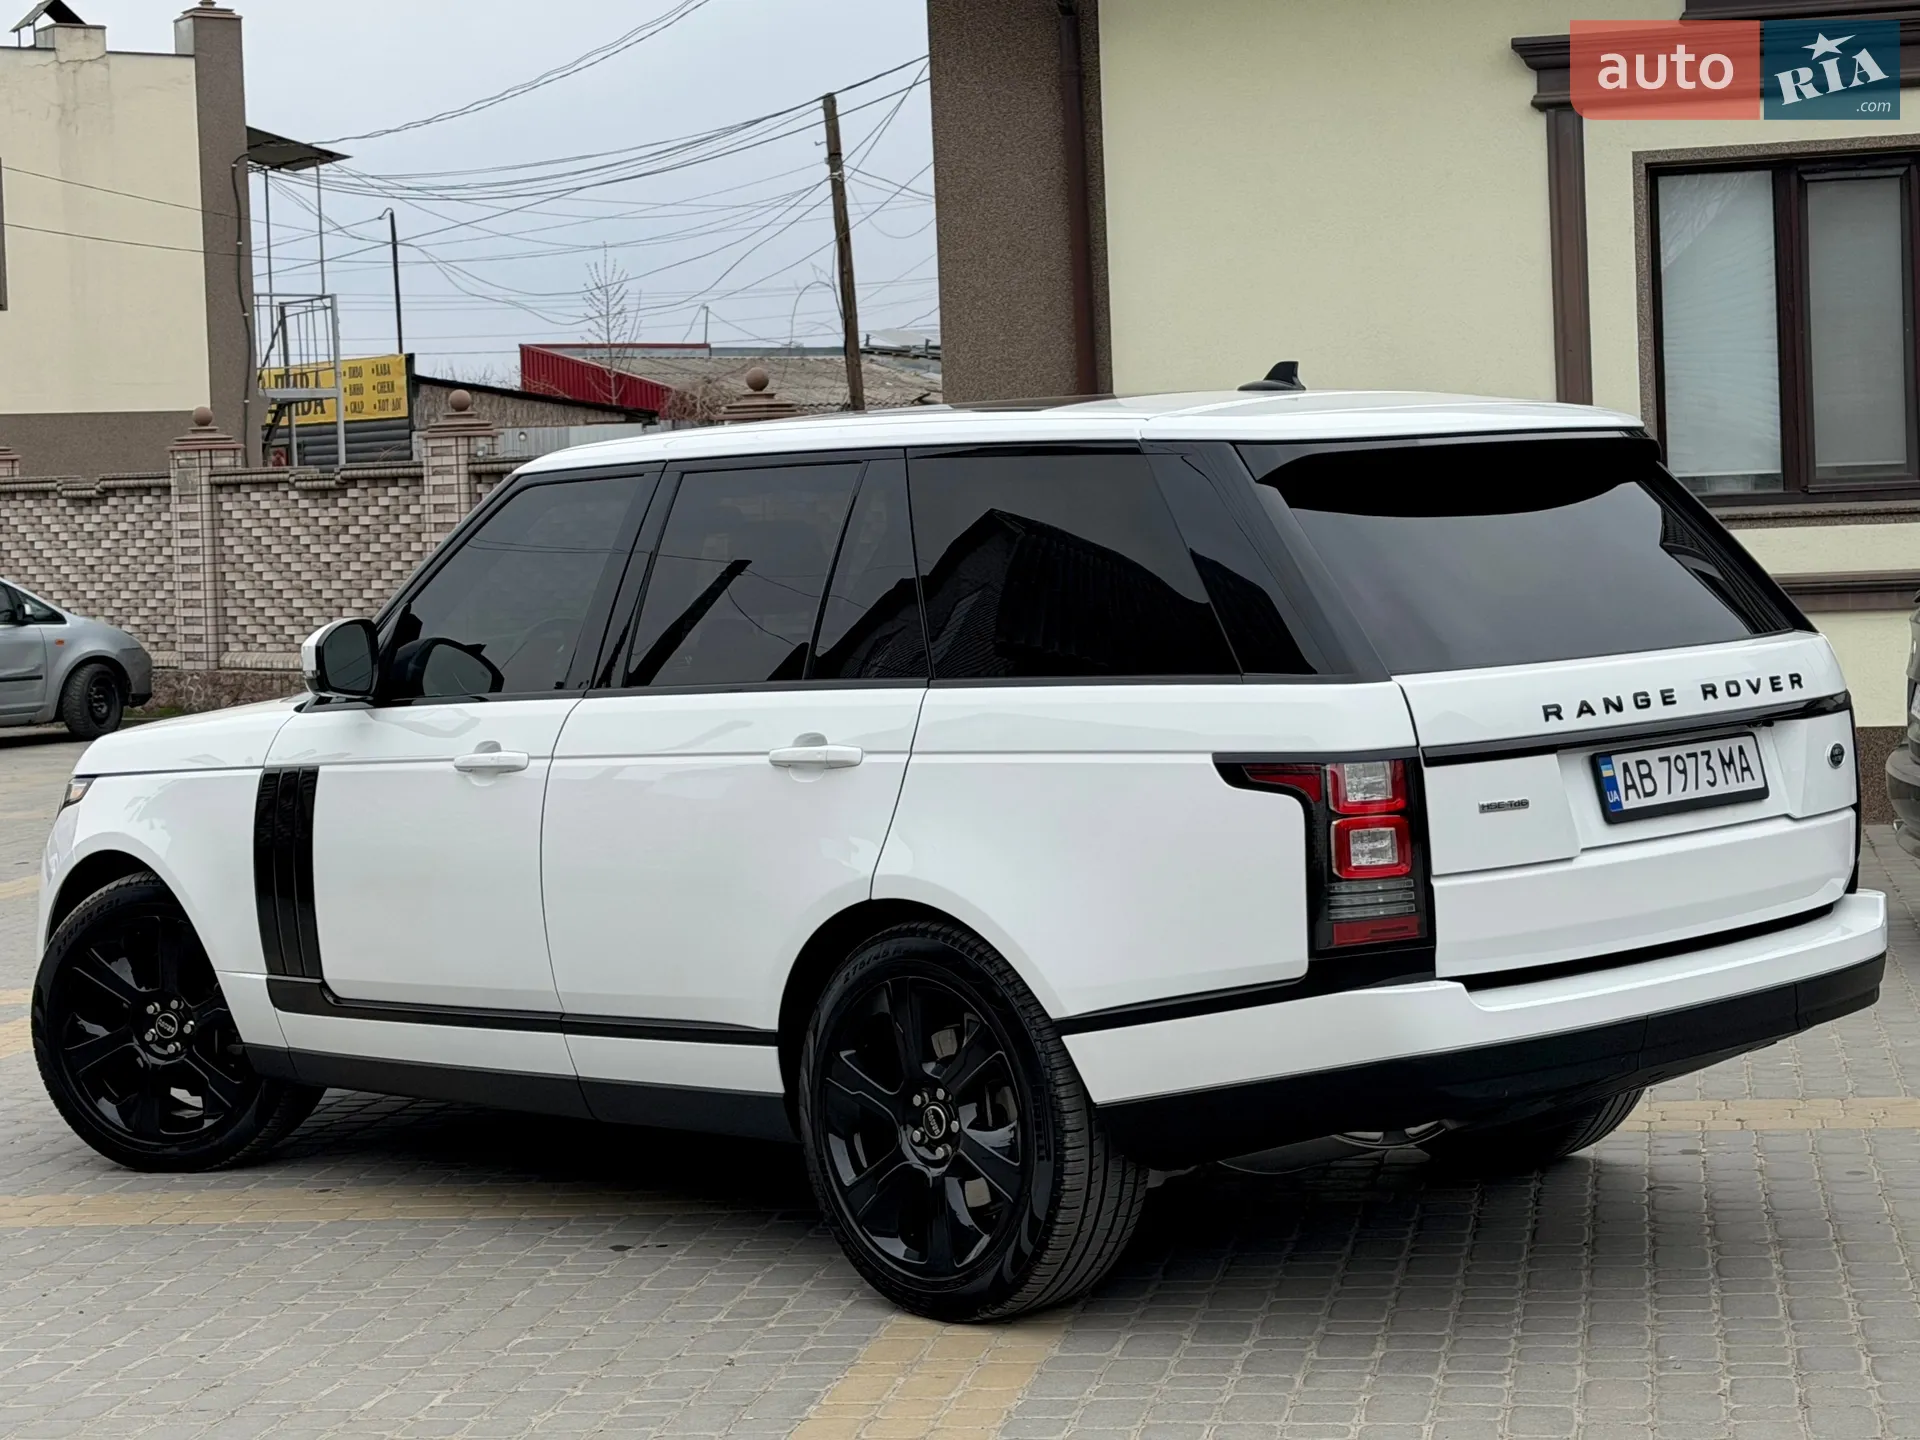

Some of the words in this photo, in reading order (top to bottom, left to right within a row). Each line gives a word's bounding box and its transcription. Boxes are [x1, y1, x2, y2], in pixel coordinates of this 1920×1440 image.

[375, 363, 391, 377] КАВА
[376, 380, 395, 394] СНЕКИ
[377, 398, 389, 412] ХОТ
[1541, 688, 1677, 723] RANGE
[1700, 672, 1804, 701] ROVER
[1622, 759, 1658, 801] AB
[1658, 750, 1718, 796] 7973
[1718, 745, 1755, 785] MA
[1606, 790, 1620, 803] UA
